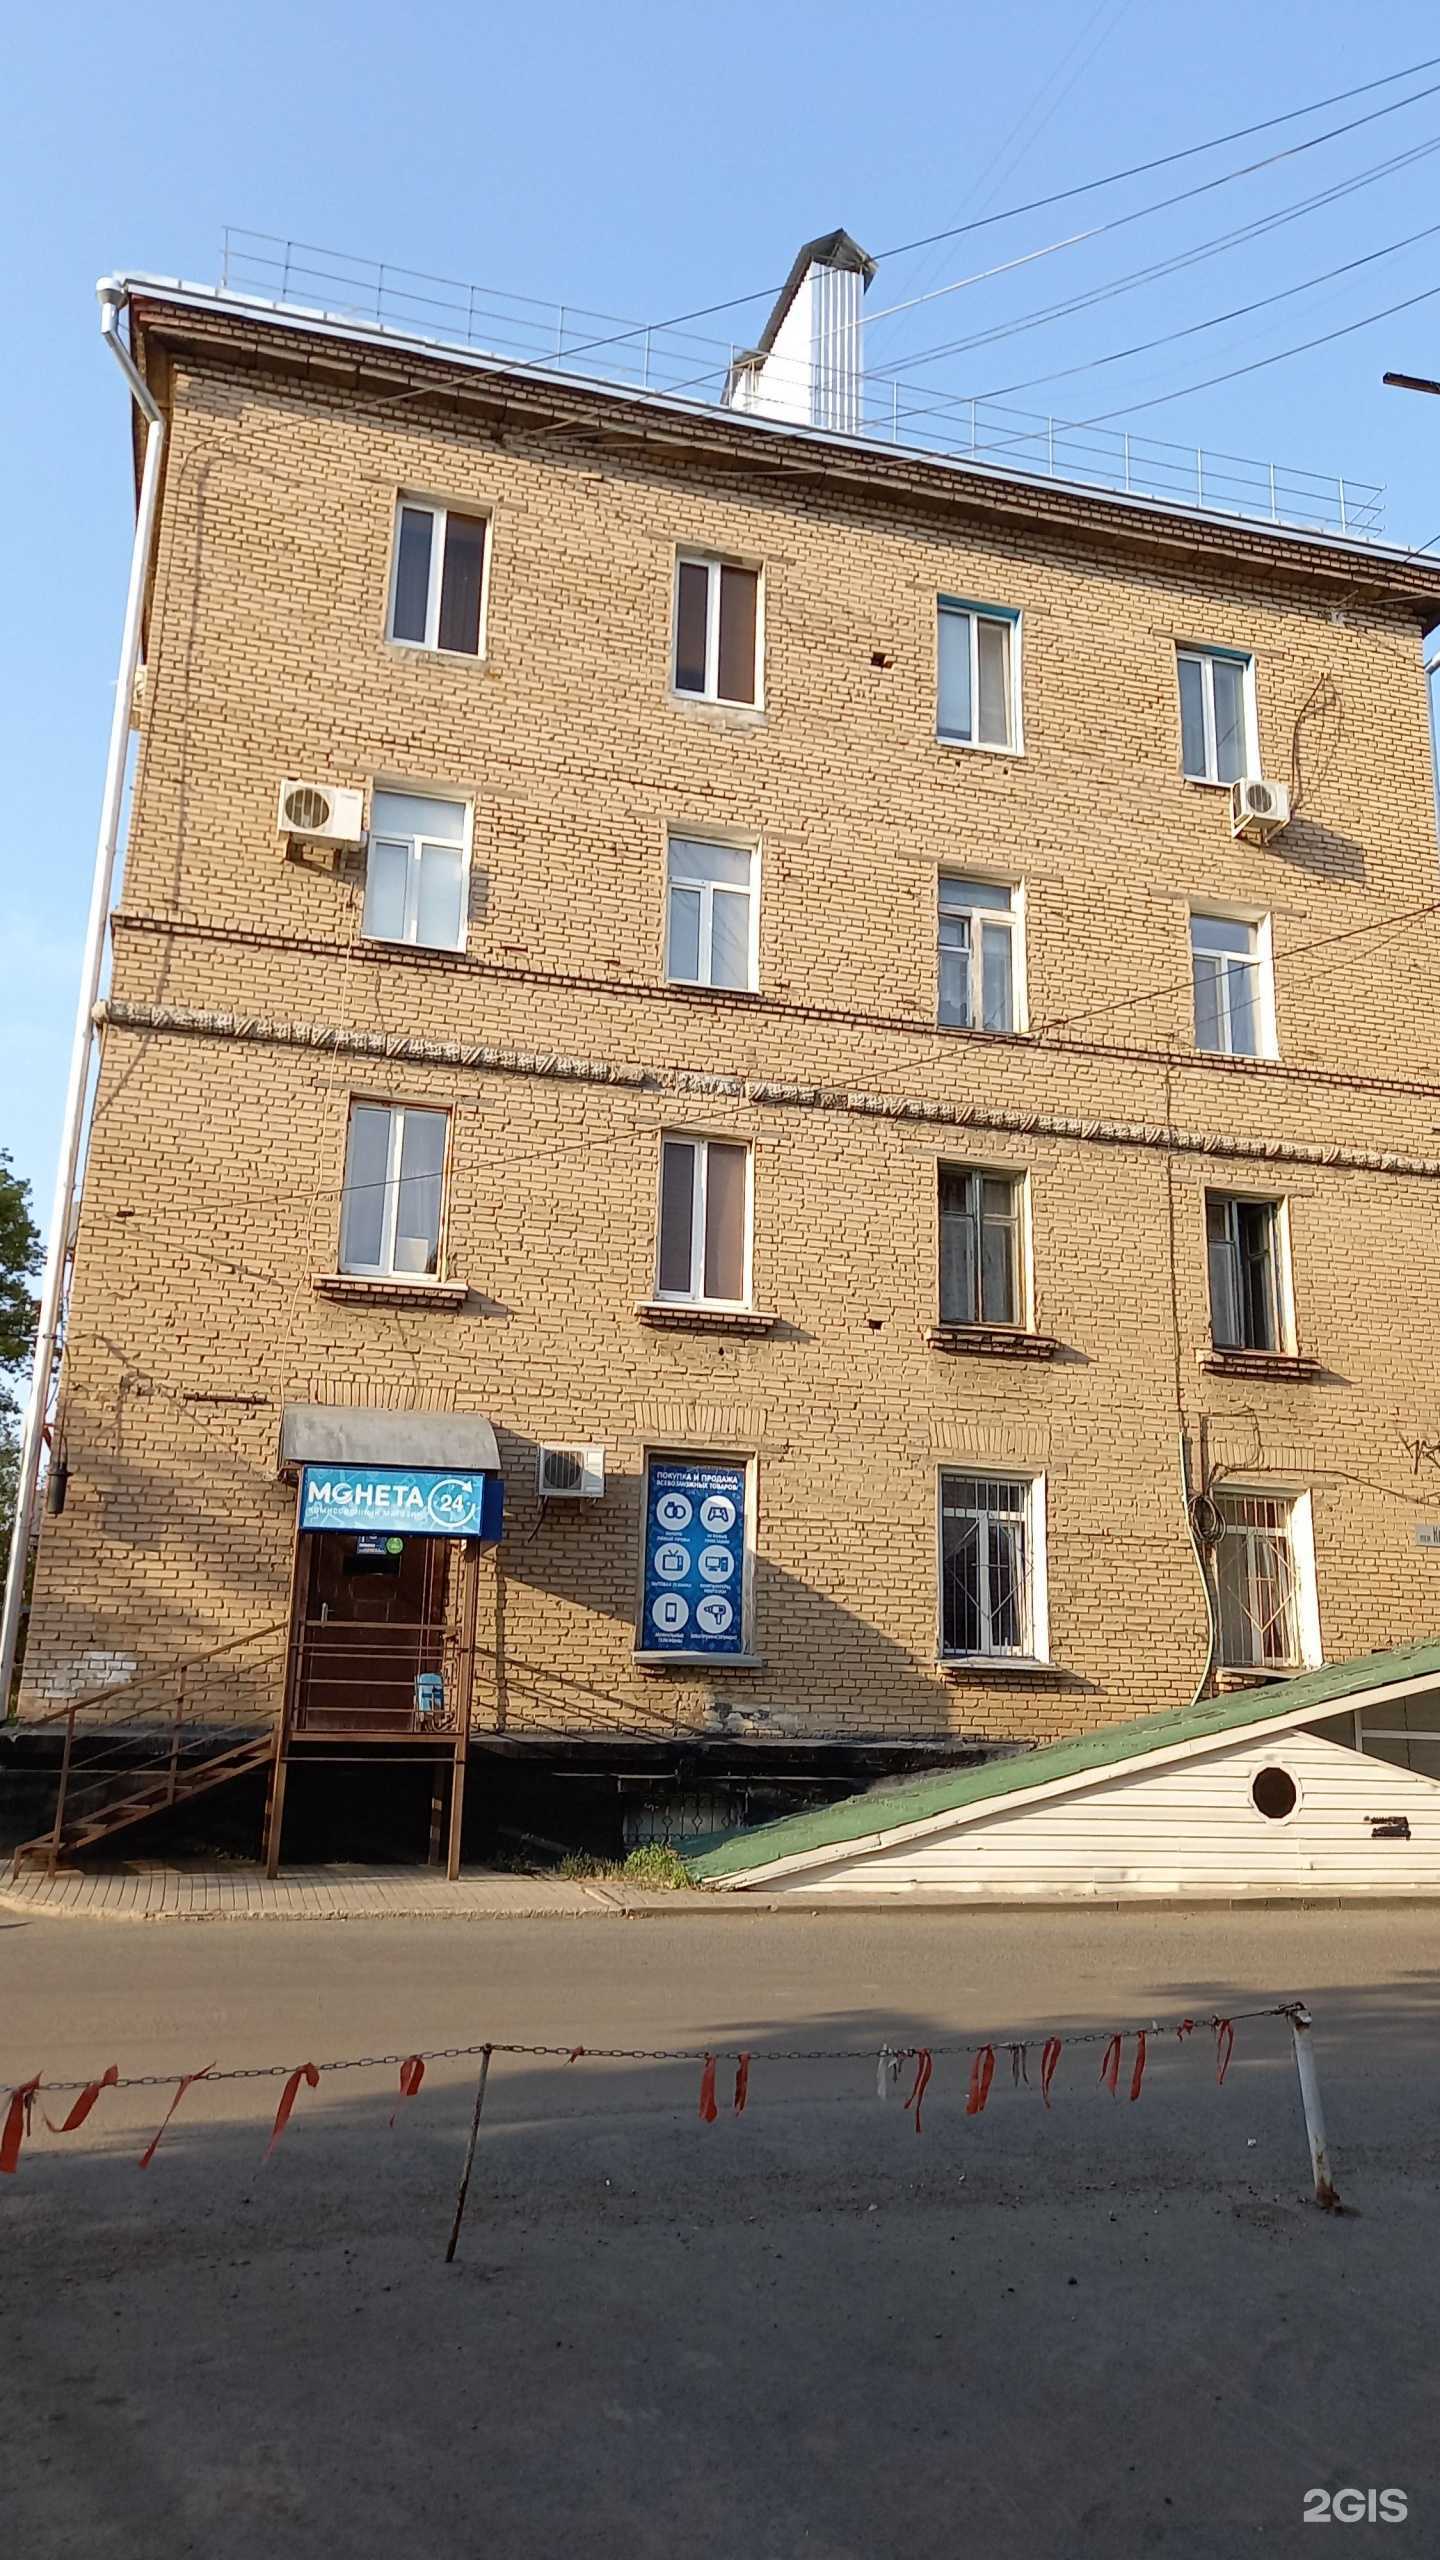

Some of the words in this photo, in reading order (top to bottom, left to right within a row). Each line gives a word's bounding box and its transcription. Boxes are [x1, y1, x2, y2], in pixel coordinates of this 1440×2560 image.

[656, 1471, 691, 1480] ПОКУПКА
[701, 1474, 738, 1484] ПРОДАЖА
[440, 1494, 464, 1512] 24
